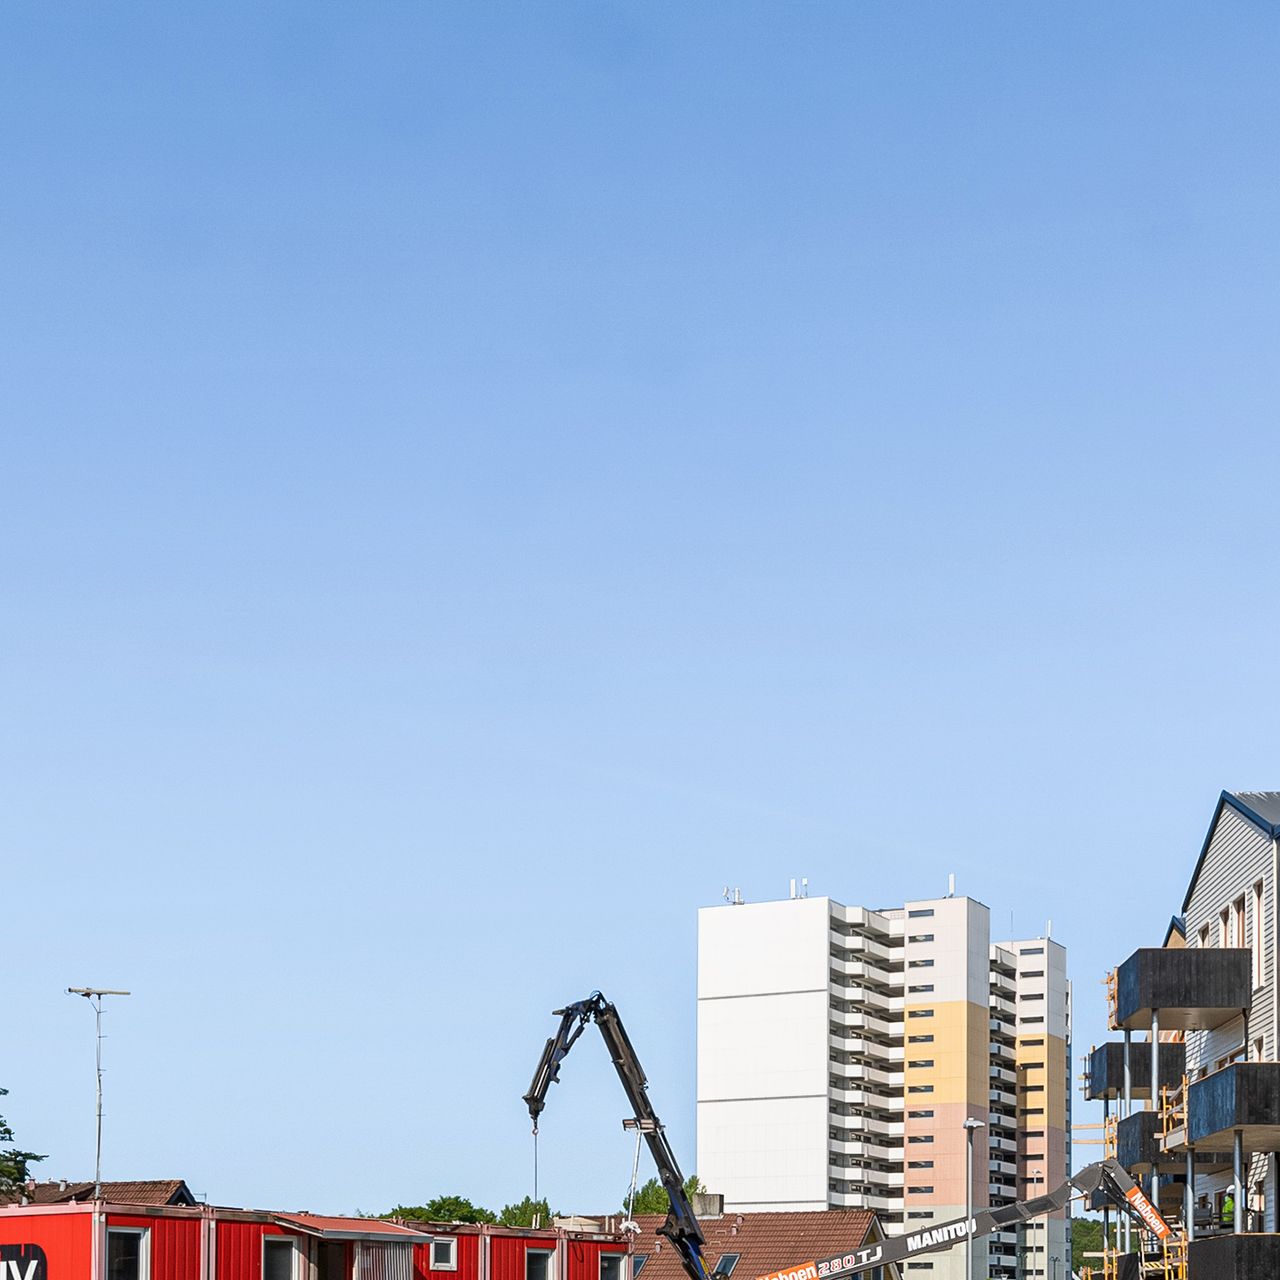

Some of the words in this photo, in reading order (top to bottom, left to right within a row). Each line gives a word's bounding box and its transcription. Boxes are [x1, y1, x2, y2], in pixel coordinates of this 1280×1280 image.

[1130, 1191, 1165, 1235] Naboen
[906, 1218, 977, 1252] MANITOU
[818, 1254, 855, 1277] 280
[857, 1245, 883, 1264] TJ
